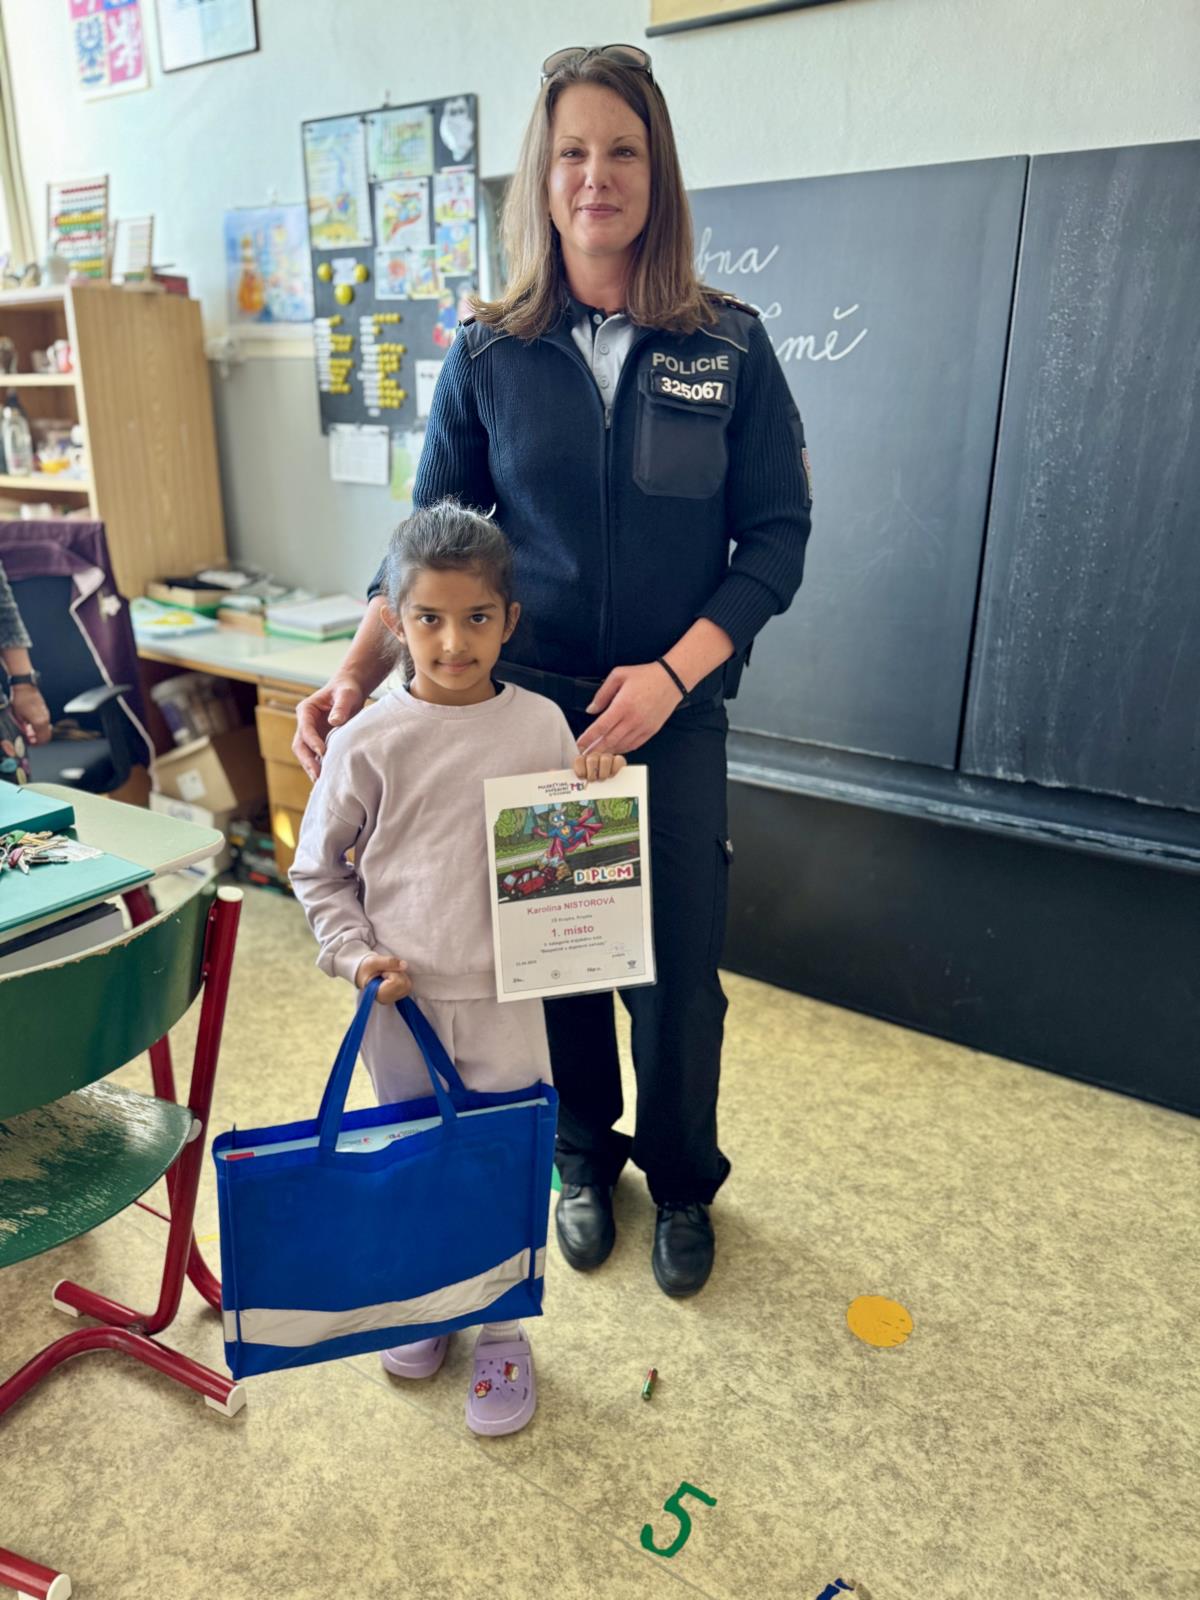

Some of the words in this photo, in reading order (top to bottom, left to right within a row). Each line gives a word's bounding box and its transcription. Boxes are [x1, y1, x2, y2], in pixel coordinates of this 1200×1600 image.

[652, 352, 729, 374] POLICIE
[661, 377, 723, 400] 325067
[574, 864, 634, 884] DIPLOM
[640, 1481, 718, 1558] 5
